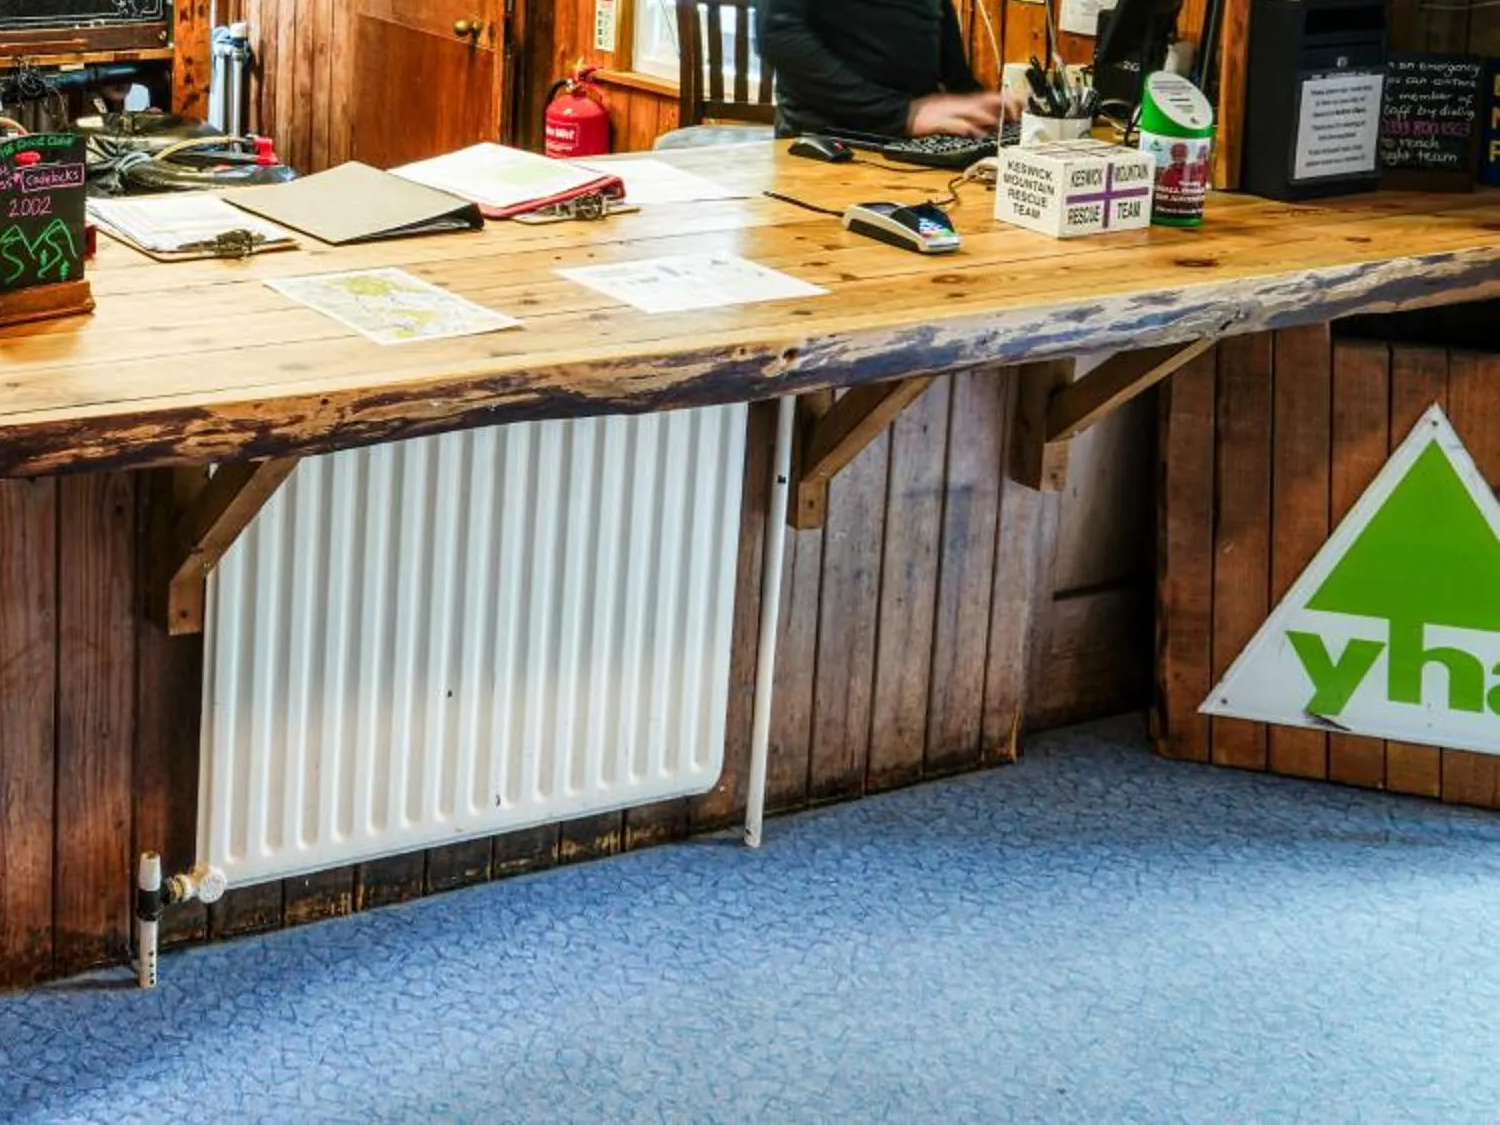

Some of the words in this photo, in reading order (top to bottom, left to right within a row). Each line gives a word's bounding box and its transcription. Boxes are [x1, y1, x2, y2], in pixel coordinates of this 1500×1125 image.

[1007, 160, 1053, 182] KESWICK
[1003, 172, 1055, 196] MOUNTAIN
[8, 195, 53, 218] 2002
[1007, 187, 1049, 209] RESCUE
[1013, 202, 1041, 220] TEAM
[1117, 200, 1141, 220] TEAM
